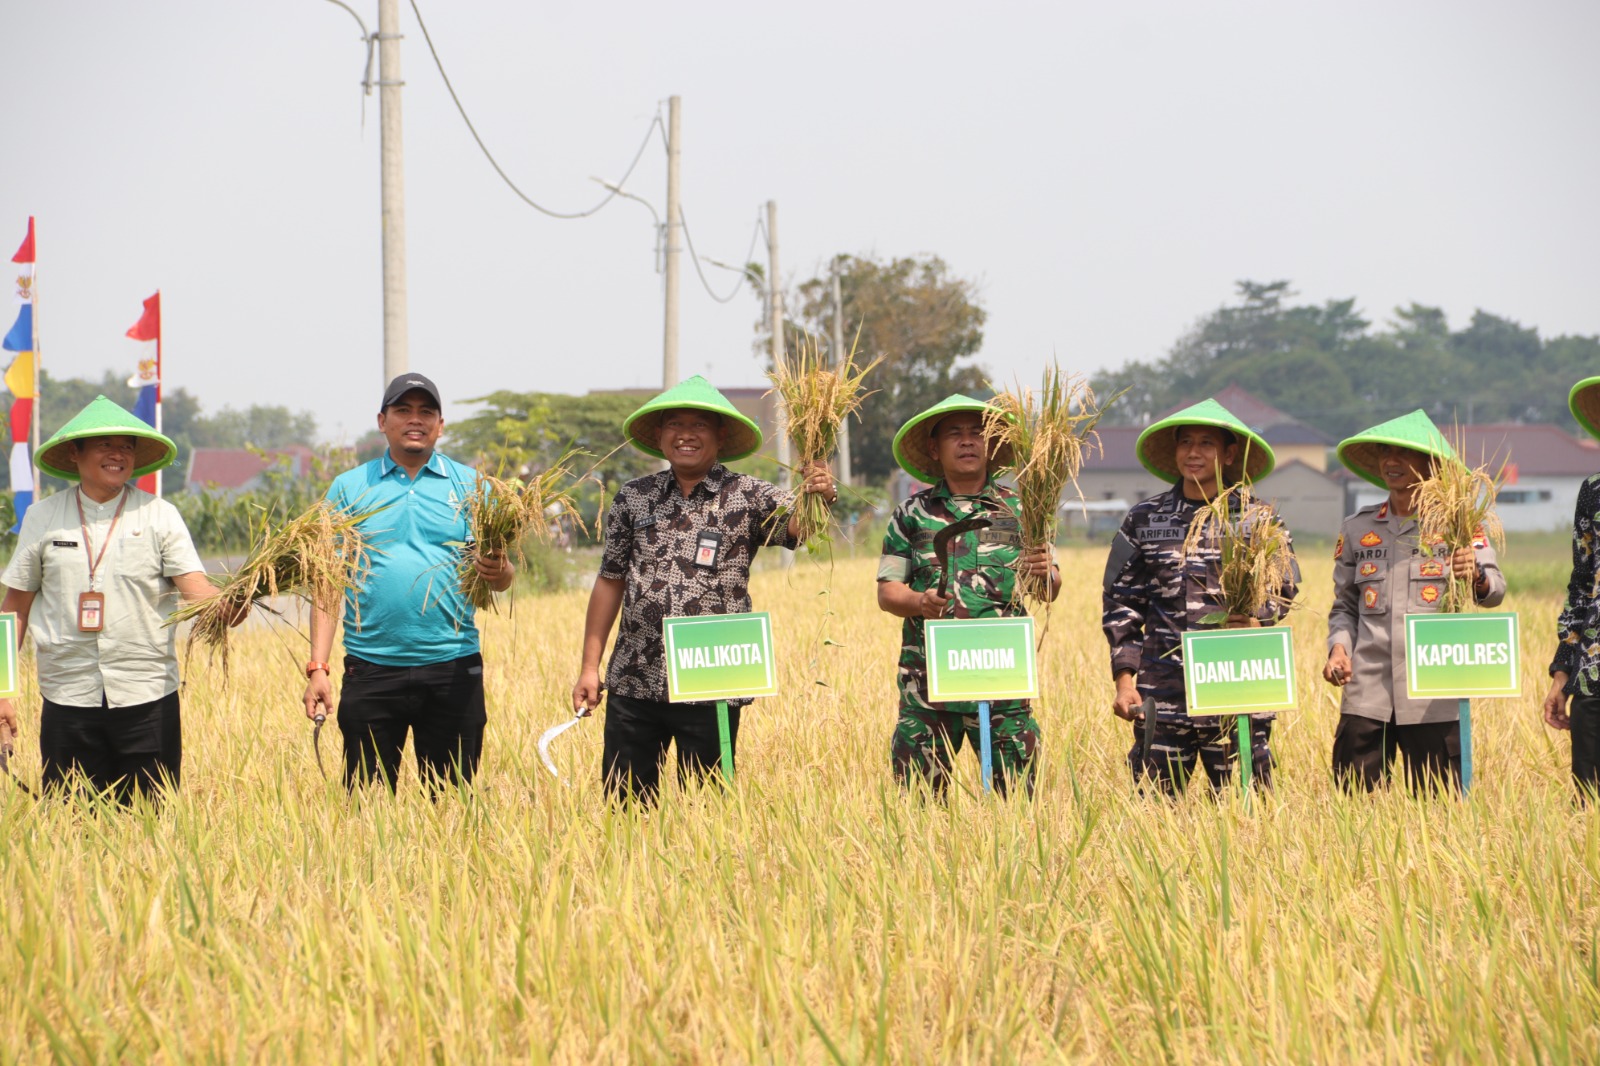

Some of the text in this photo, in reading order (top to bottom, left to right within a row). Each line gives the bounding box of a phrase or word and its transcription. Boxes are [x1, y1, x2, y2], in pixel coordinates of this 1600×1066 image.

[984, 531, 1001, 541] TNI
[1140, 528, 1180, 539] ARIFIEN
[1354, 548, 1388, 561] PARDI
[677, 643, 763, 670] WALIKOTA
[948, 648, 1015, 671] DANDIM
[1417, 642, 1509, 666] KAPOLRES
[1194, 657, 1286, 684] DANLANAL
